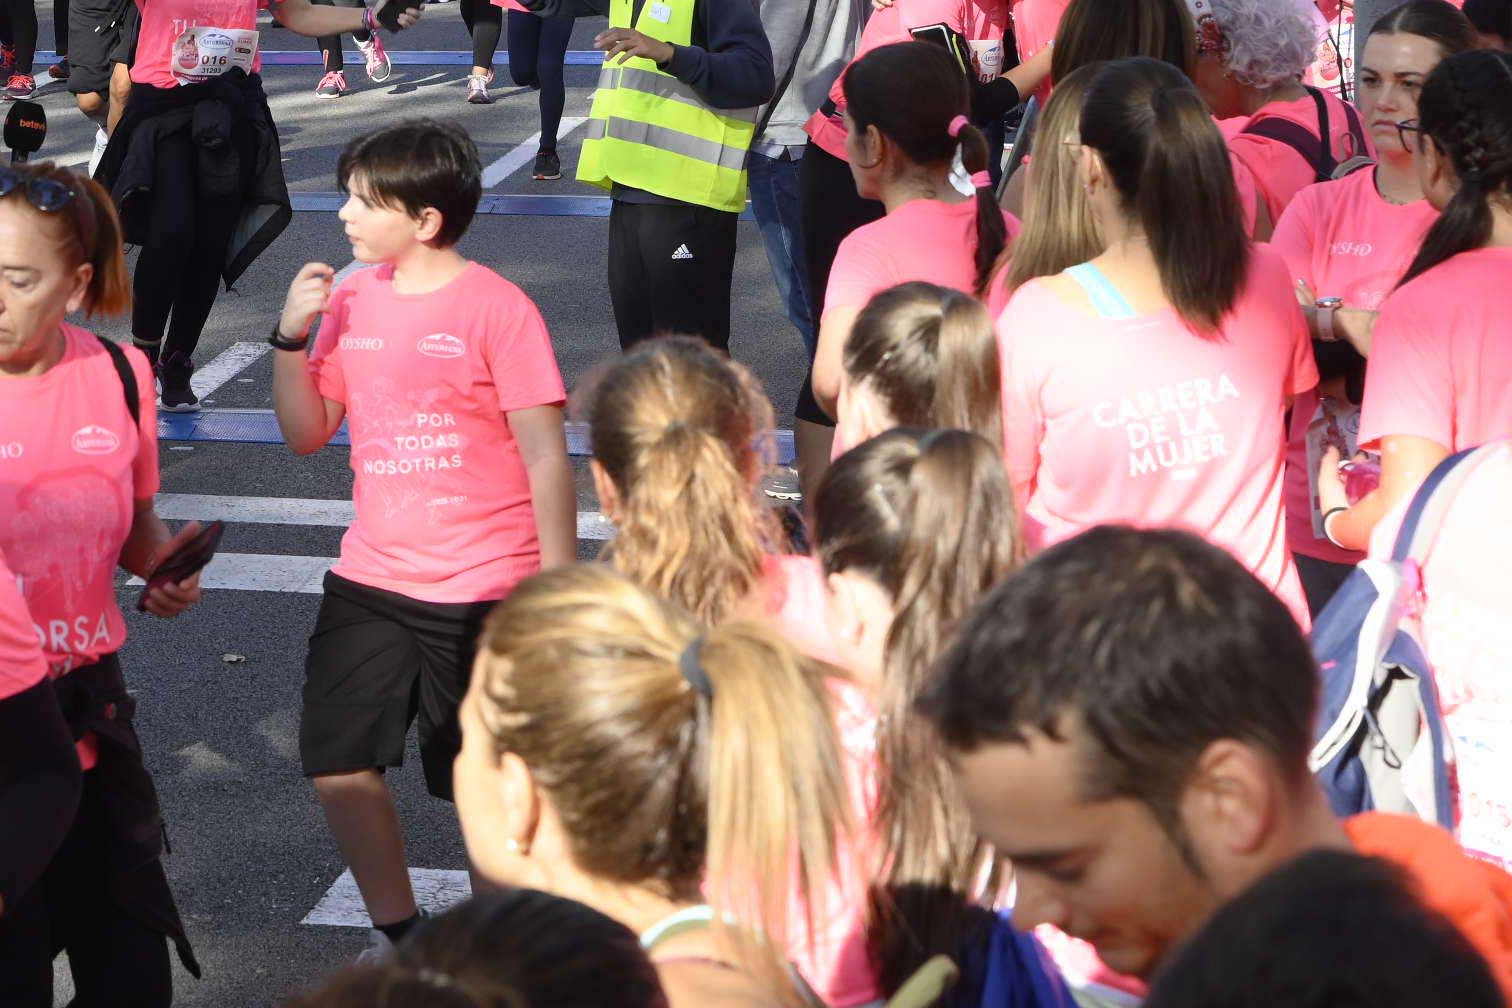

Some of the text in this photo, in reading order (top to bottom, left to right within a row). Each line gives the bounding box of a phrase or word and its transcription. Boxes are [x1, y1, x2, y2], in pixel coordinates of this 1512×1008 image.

[201, 55, 228, 65] 016
[1092, 372, 1239, 429] CARRERA
[416, 413, 456, 428] POR
[1128, 405, 1220, 451] DE LA
[393, 434, 460, 450] TODAS
[1129, 431, 1227, 477] MUJER
[363, 455, 464, 474] NOSOTRAS
